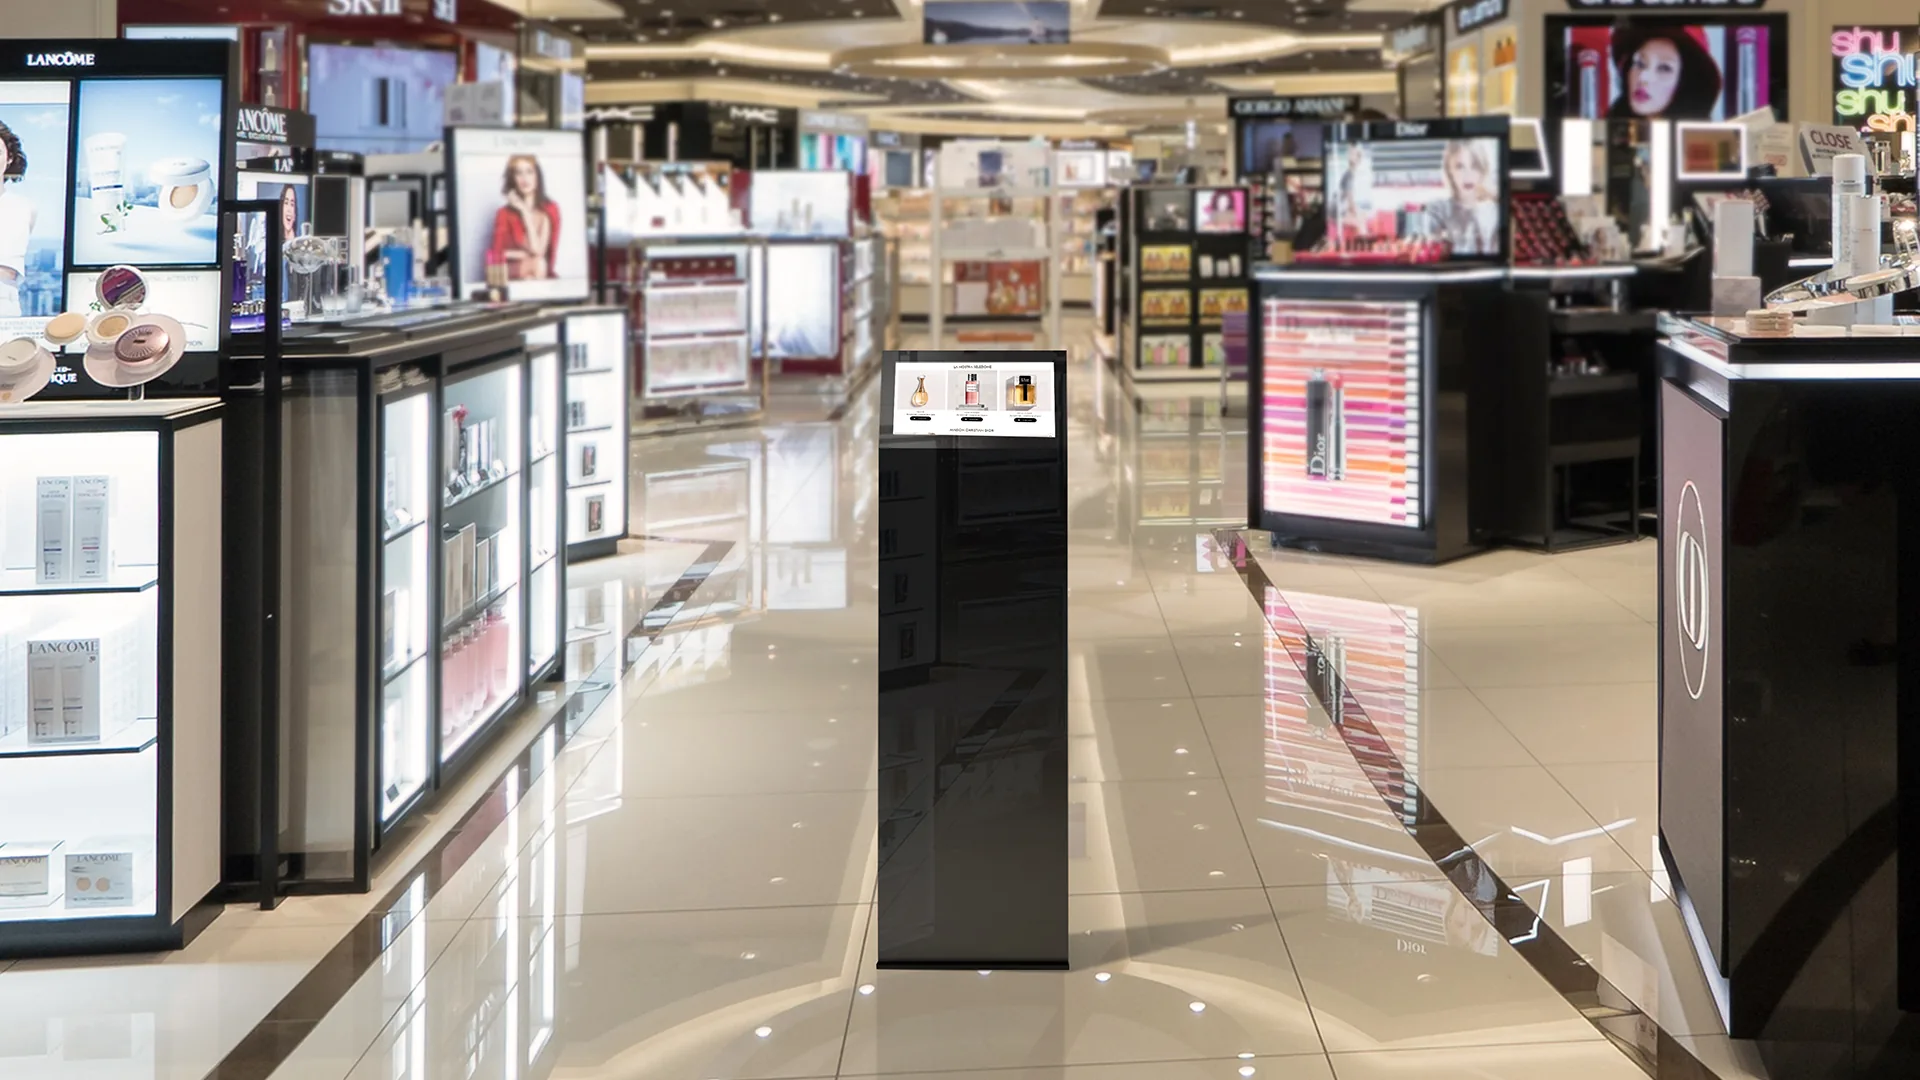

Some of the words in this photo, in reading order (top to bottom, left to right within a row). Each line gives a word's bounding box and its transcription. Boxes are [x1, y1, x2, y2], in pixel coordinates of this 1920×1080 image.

[1831, 26, 1900, 56] shu
[26, 51, 96, 66] LANCÔME
[1836, 86, 1906, 115] shu
[1395, 121, 1429, 137] Dior
[1810, 130, 1854, 150] CLOSE
[1310, 432, 1326, 476] Dior
